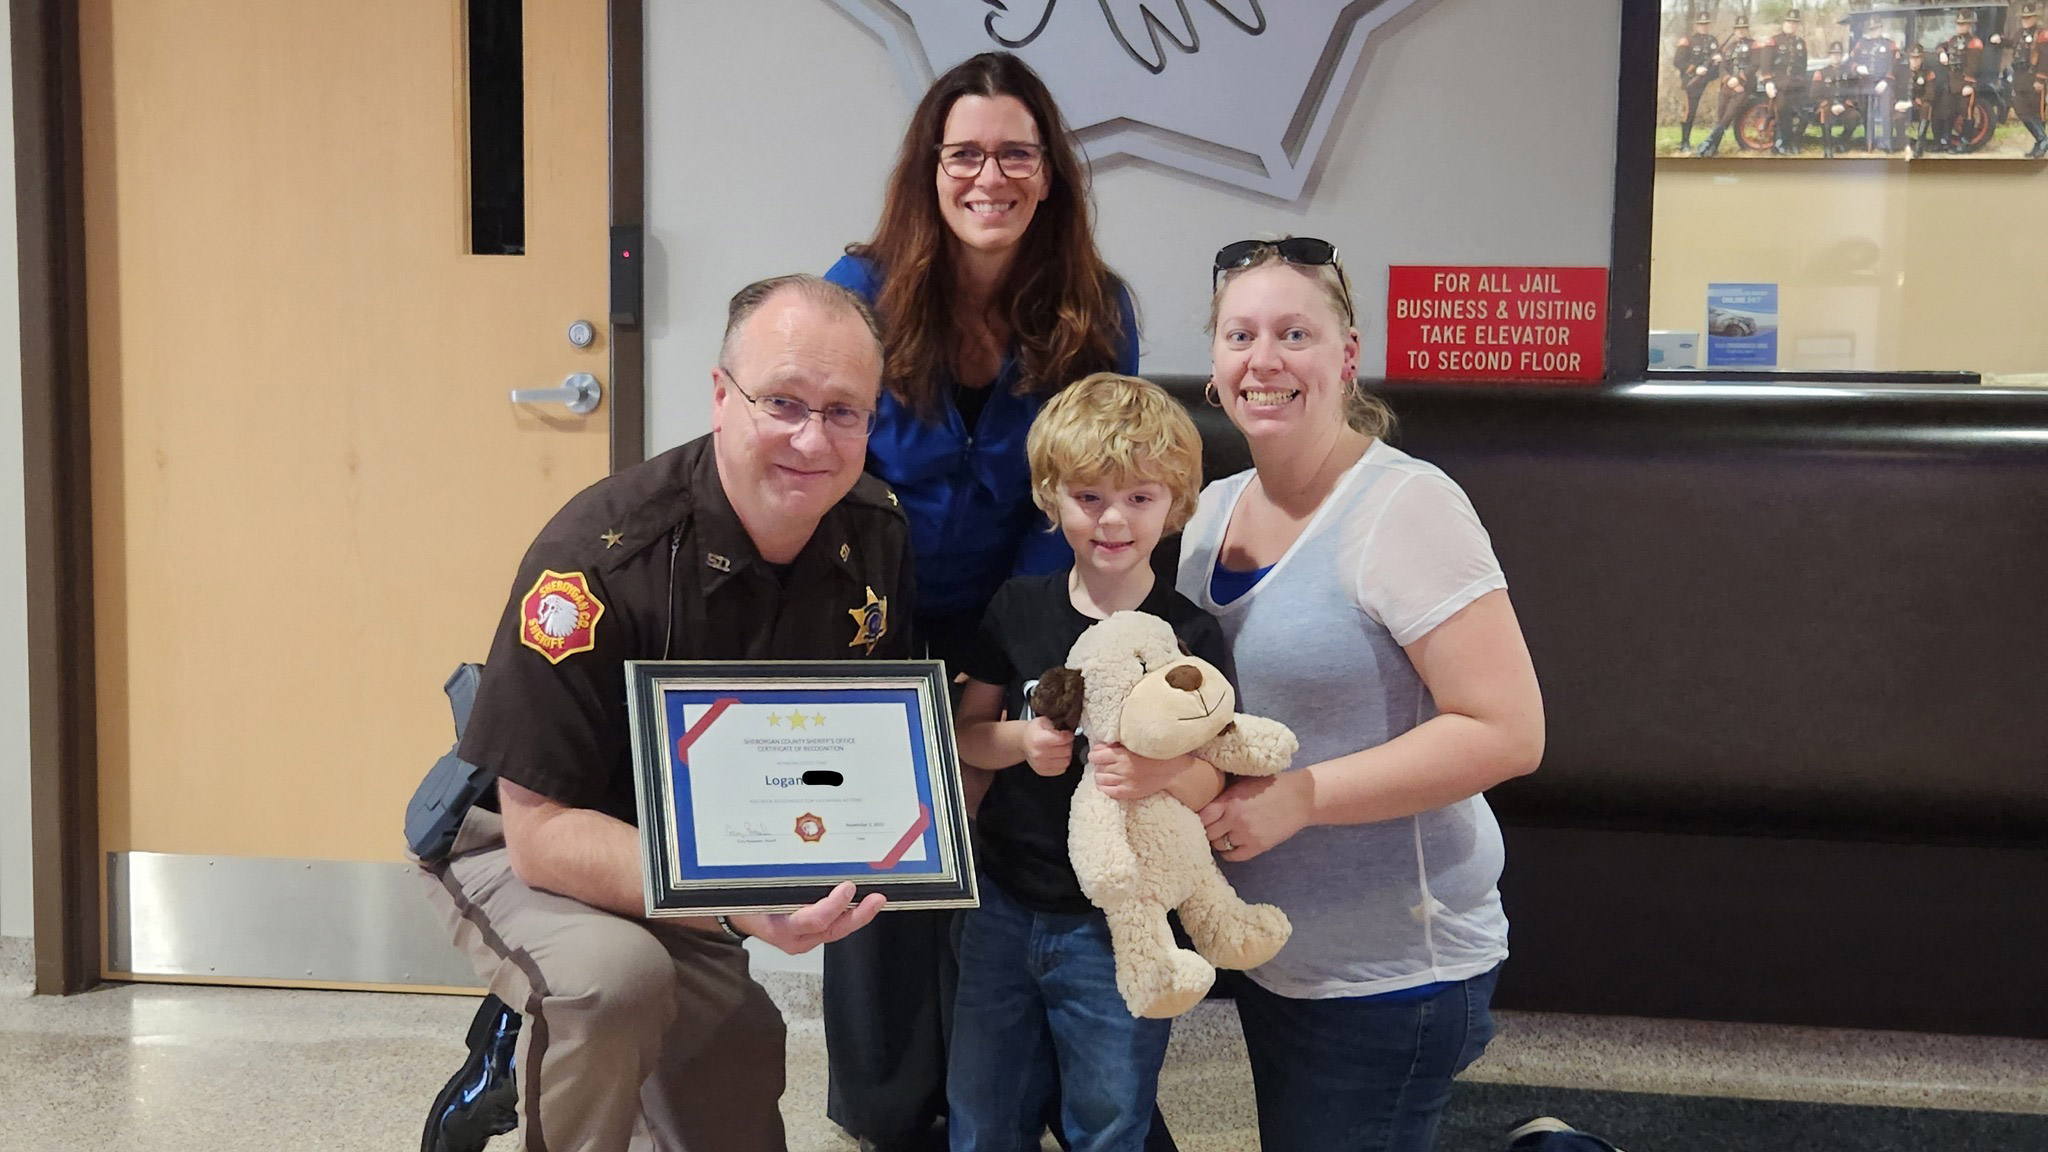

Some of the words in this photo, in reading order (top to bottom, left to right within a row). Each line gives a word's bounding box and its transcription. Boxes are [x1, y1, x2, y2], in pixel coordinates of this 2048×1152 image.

[1433, 273, 1470, 293] FOR
[1477, 273, 1512, 293] ALL
[1519, 273, 1561, 294] JAIL
[1396, 299, 1488, 319] BUSINESS
[1496, 300, 1509, 319] &
[1517, 300, 1597, 321] VISITING
[1420, 325, 1467, 344] TAKE
[1475, 325, 1570, 346] ELEVATOR
[1407, 350, 1430, 370] TO
[1438, 351, 1512, 371] SECOND
[1520, 352, 1581, 372] FLOOR
[539, 580, 590, 612] SHEBOYGAN
[528, 617, 566, 649] SHERIFF
[765, 775, 803, 788] Logan
